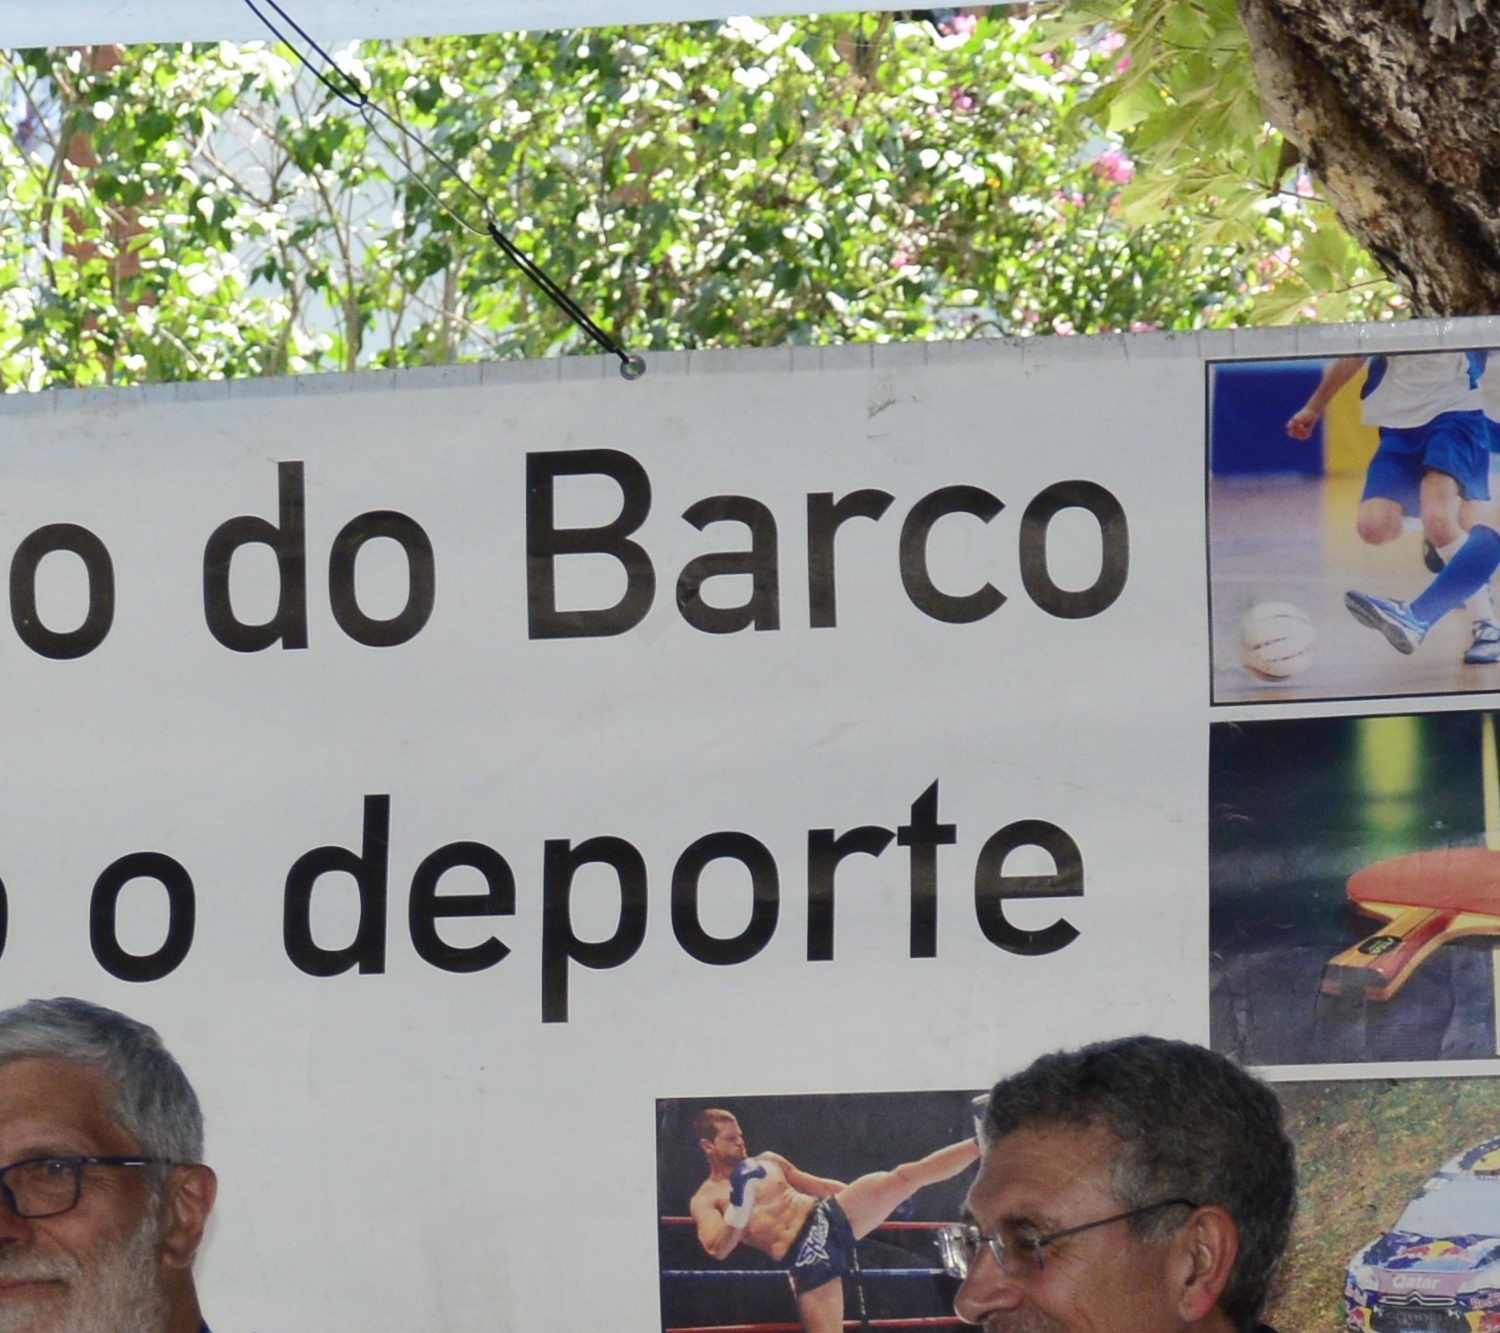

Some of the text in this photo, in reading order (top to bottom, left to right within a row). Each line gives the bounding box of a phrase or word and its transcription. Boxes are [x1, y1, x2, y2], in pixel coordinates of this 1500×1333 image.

[201, 460, 435, 653] do
[525, 447, 1130, 640] Barco
[89, 850, 196, 983] o
[282, 776, 1086, 1024] deporte
[1393, 1274, 1441, 1290] Qatar
